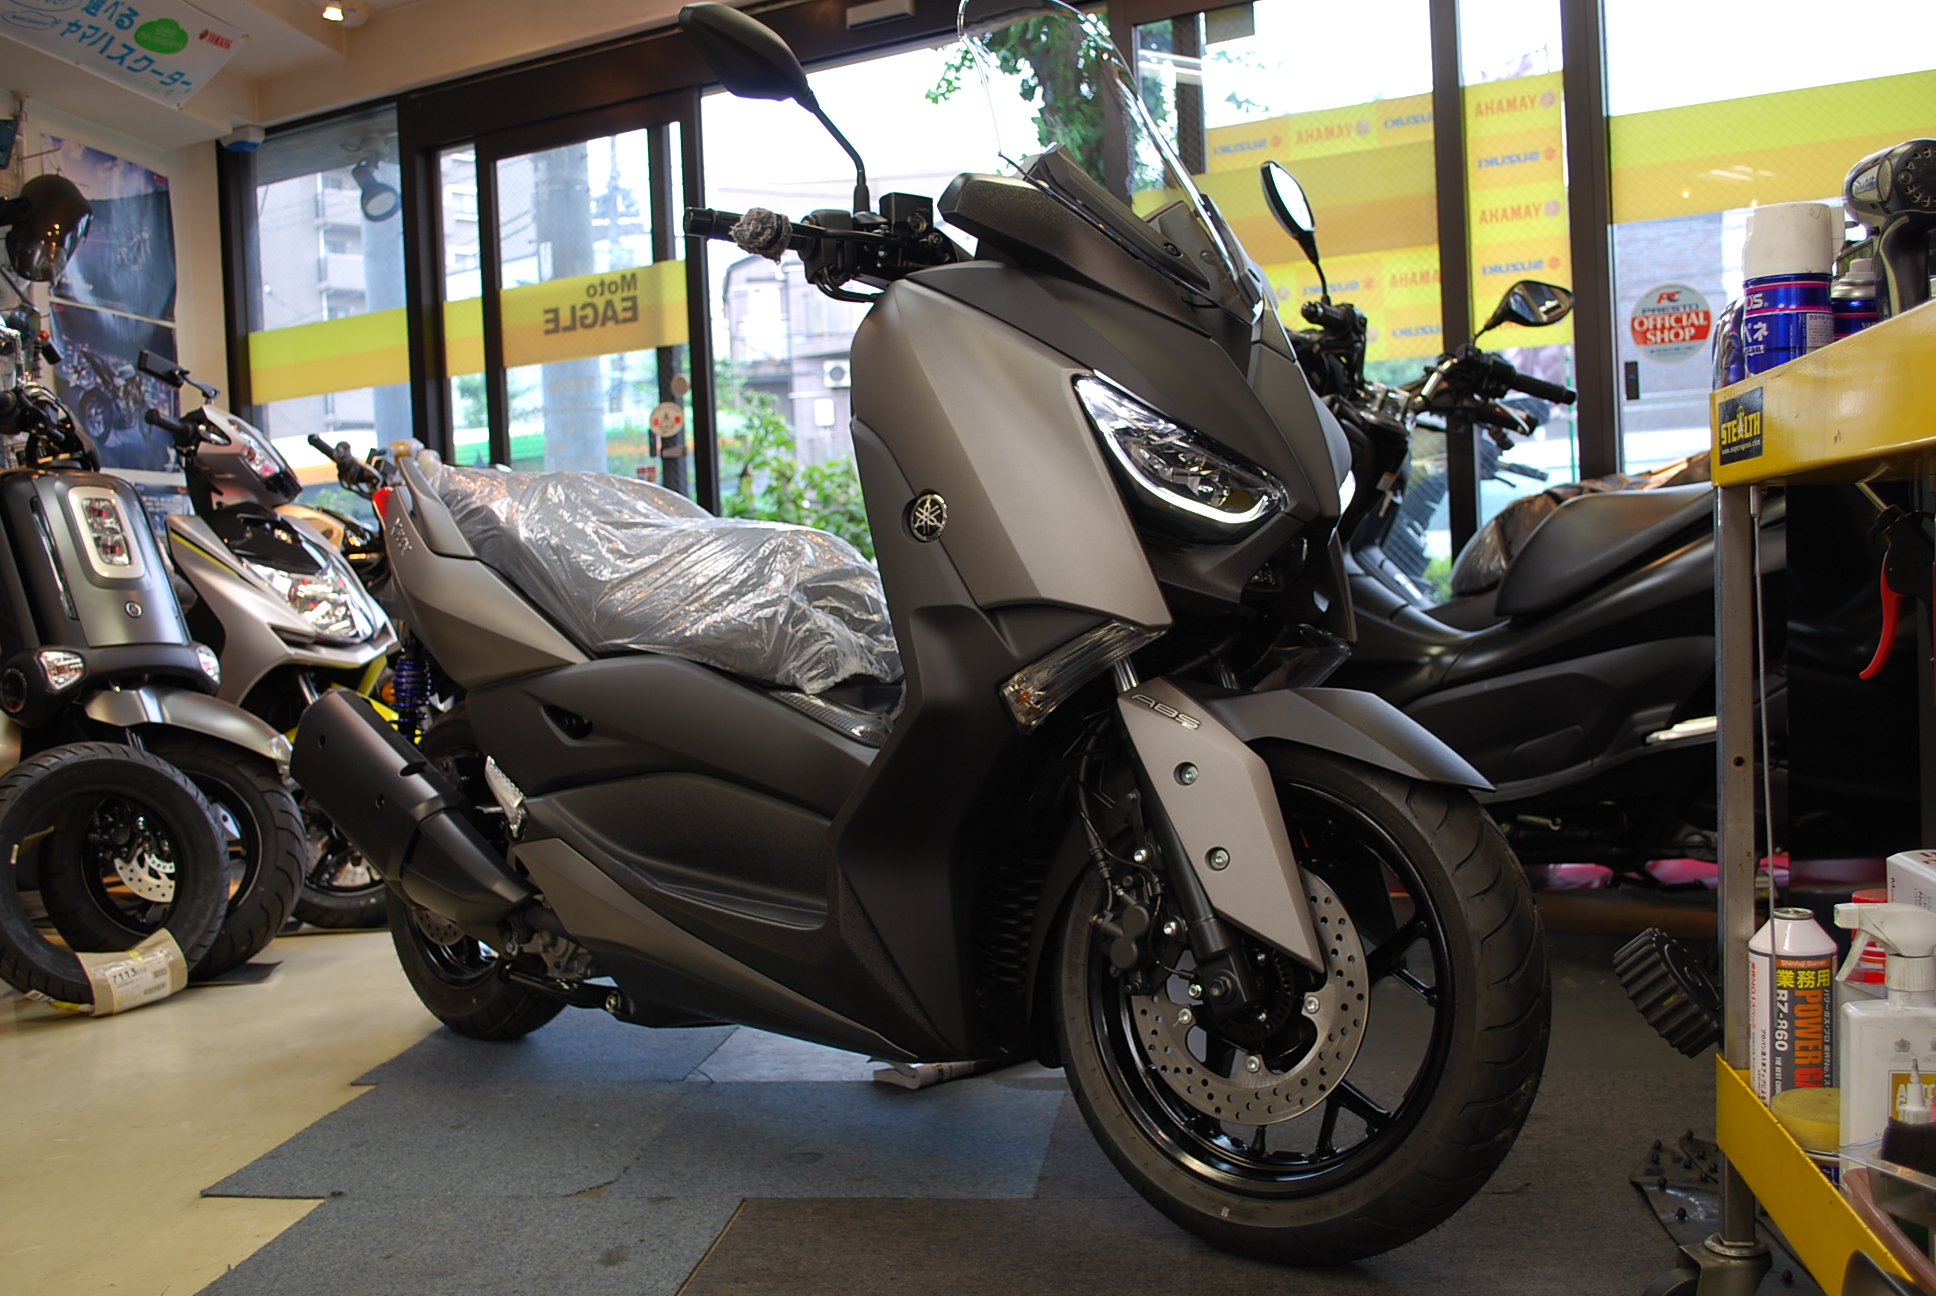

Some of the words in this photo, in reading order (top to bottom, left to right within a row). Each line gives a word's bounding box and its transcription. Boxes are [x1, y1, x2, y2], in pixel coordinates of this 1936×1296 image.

[206, 32, 234, 50] YAMAHA
[60, 19, 192, 87] ヤマハスクーター
[1641, 303, 1699, 315] PRESTO
[1633, 311, 1709, 333] OFFICIAL
[1646, 326, 1697, 345] SHOP
[1721, 406, 1761, 446] STEALTH
[1131, 693, 1201, 731] ABS
[1780, 959, 1806, 968] Shinfuji
[1806, 959, 1827, 967] Burner
[1776, 968, 1831, 989] 業務用
[1774, 989, 1789, 1051] RZ-860
[1794, 989, 1823, 1065] POWER
